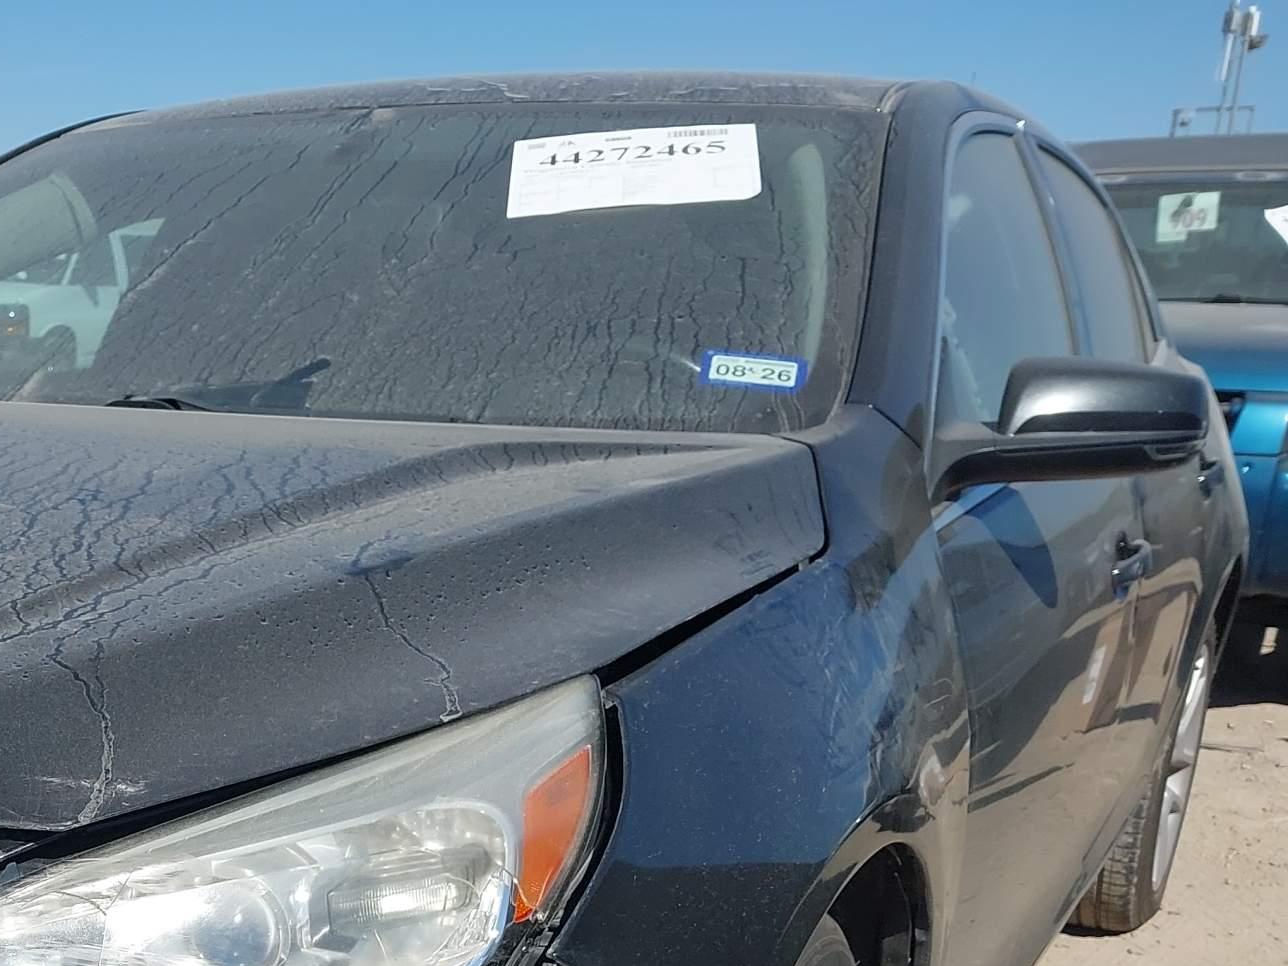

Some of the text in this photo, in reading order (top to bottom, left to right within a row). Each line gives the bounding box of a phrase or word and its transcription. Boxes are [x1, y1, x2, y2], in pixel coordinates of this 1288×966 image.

[539, 139, 727, 166] 44272465
[716, 363, 747, 378] 08
[760, 367, 793, 382] 26
